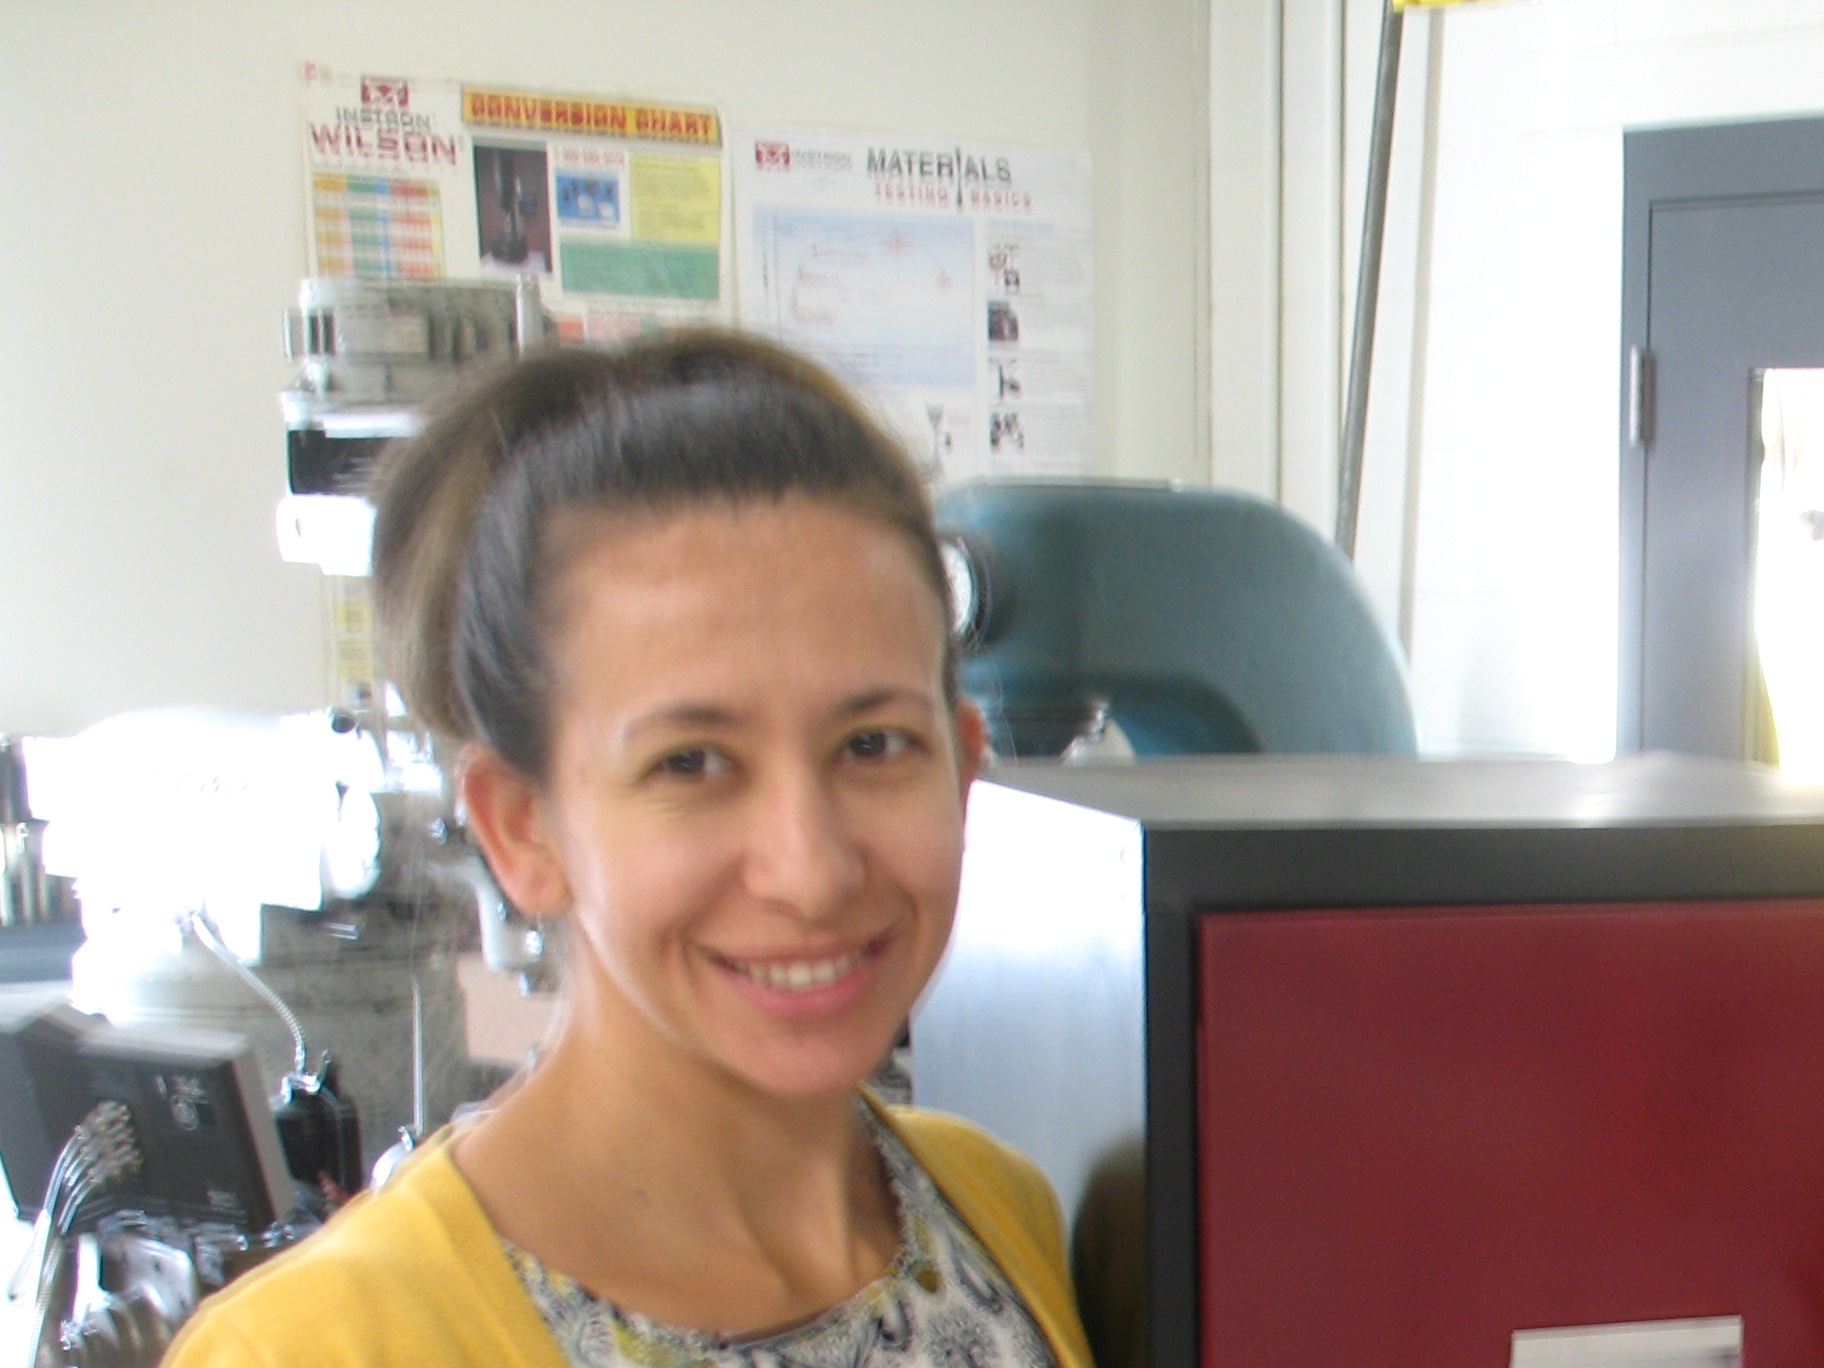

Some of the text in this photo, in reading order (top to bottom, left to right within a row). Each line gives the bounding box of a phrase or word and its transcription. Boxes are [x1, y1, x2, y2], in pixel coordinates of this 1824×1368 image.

[471, 93, 714, 141] CONVERSION CHART
[309, 124, 457, 165] WILSON
